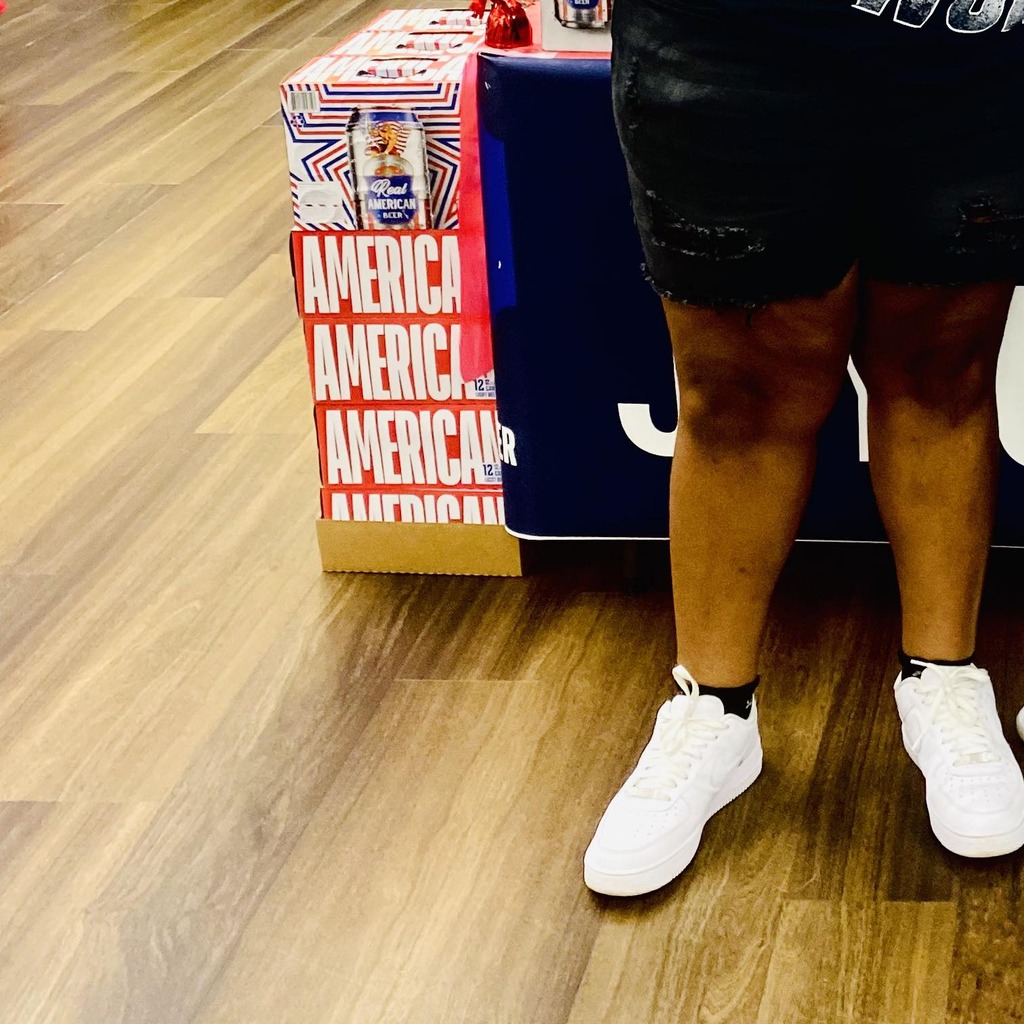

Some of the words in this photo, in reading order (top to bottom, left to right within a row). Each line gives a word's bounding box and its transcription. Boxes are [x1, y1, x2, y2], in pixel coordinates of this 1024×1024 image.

[371, 178, 408, 197] Real
[367, 198, 417, 210] AMERICAN
[302, 233, 462, 315] AMERICA
[313, 322, 497, 401] AMERIC
[474, 379, 485, 391] 12
[483, 464, 494, 476] 12
